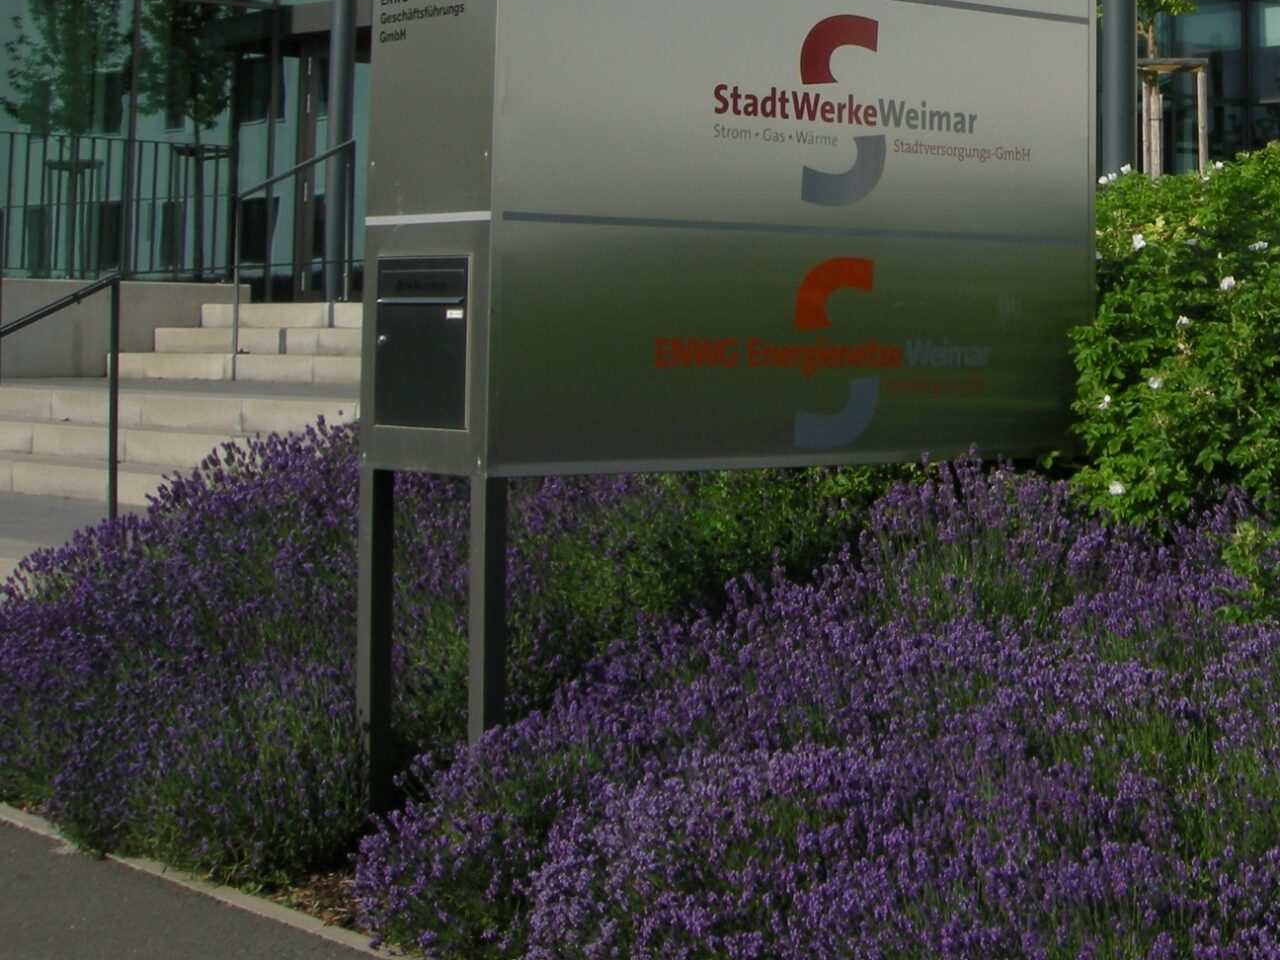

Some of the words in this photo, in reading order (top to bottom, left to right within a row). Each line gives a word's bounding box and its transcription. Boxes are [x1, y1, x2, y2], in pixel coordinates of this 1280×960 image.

[380, 3, 465, 25] Geschäftsführungs
[379, 28, 407, 43] GmbH
[713, 123, 752, 140] Strom
[762, 127, 785, 142] Gas
[795, 130, 839, 147] Wärme
[894, 139, 1031, 163] Stadtversorgungs-GmbH
[654, 337, 739, 369] ENWG
